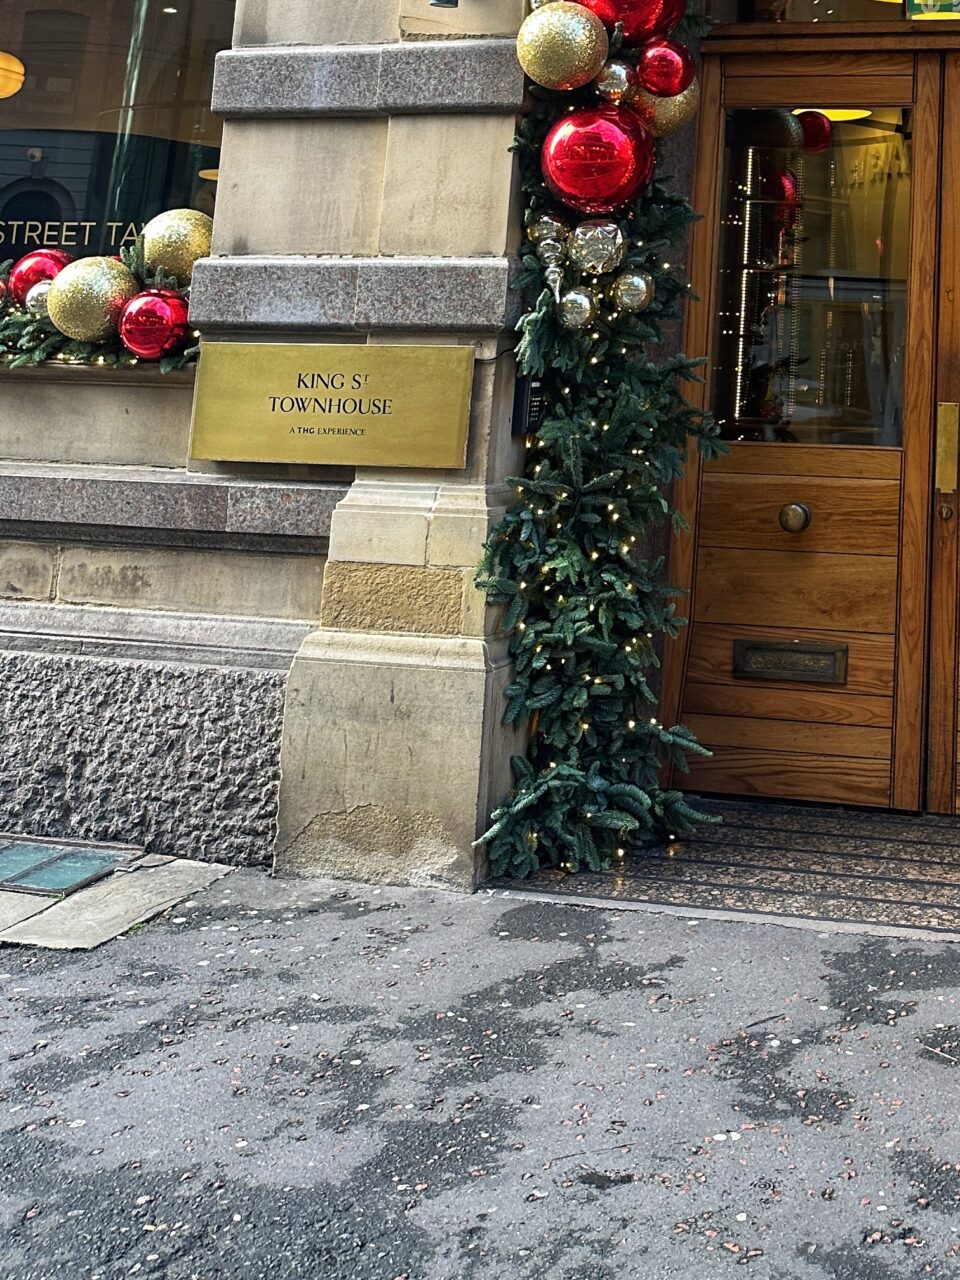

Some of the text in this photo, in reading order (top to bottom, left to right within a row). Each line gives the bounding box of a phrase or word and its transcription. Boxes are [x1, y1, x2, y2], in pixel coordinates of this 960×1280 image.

[107, 221, 145, 246] TA
[297, 372, 345, 390] KING
[268, 396, 393, 415] TOWNHOUSE
[289, 426, 367, 436] A THG EXPERIENCE
